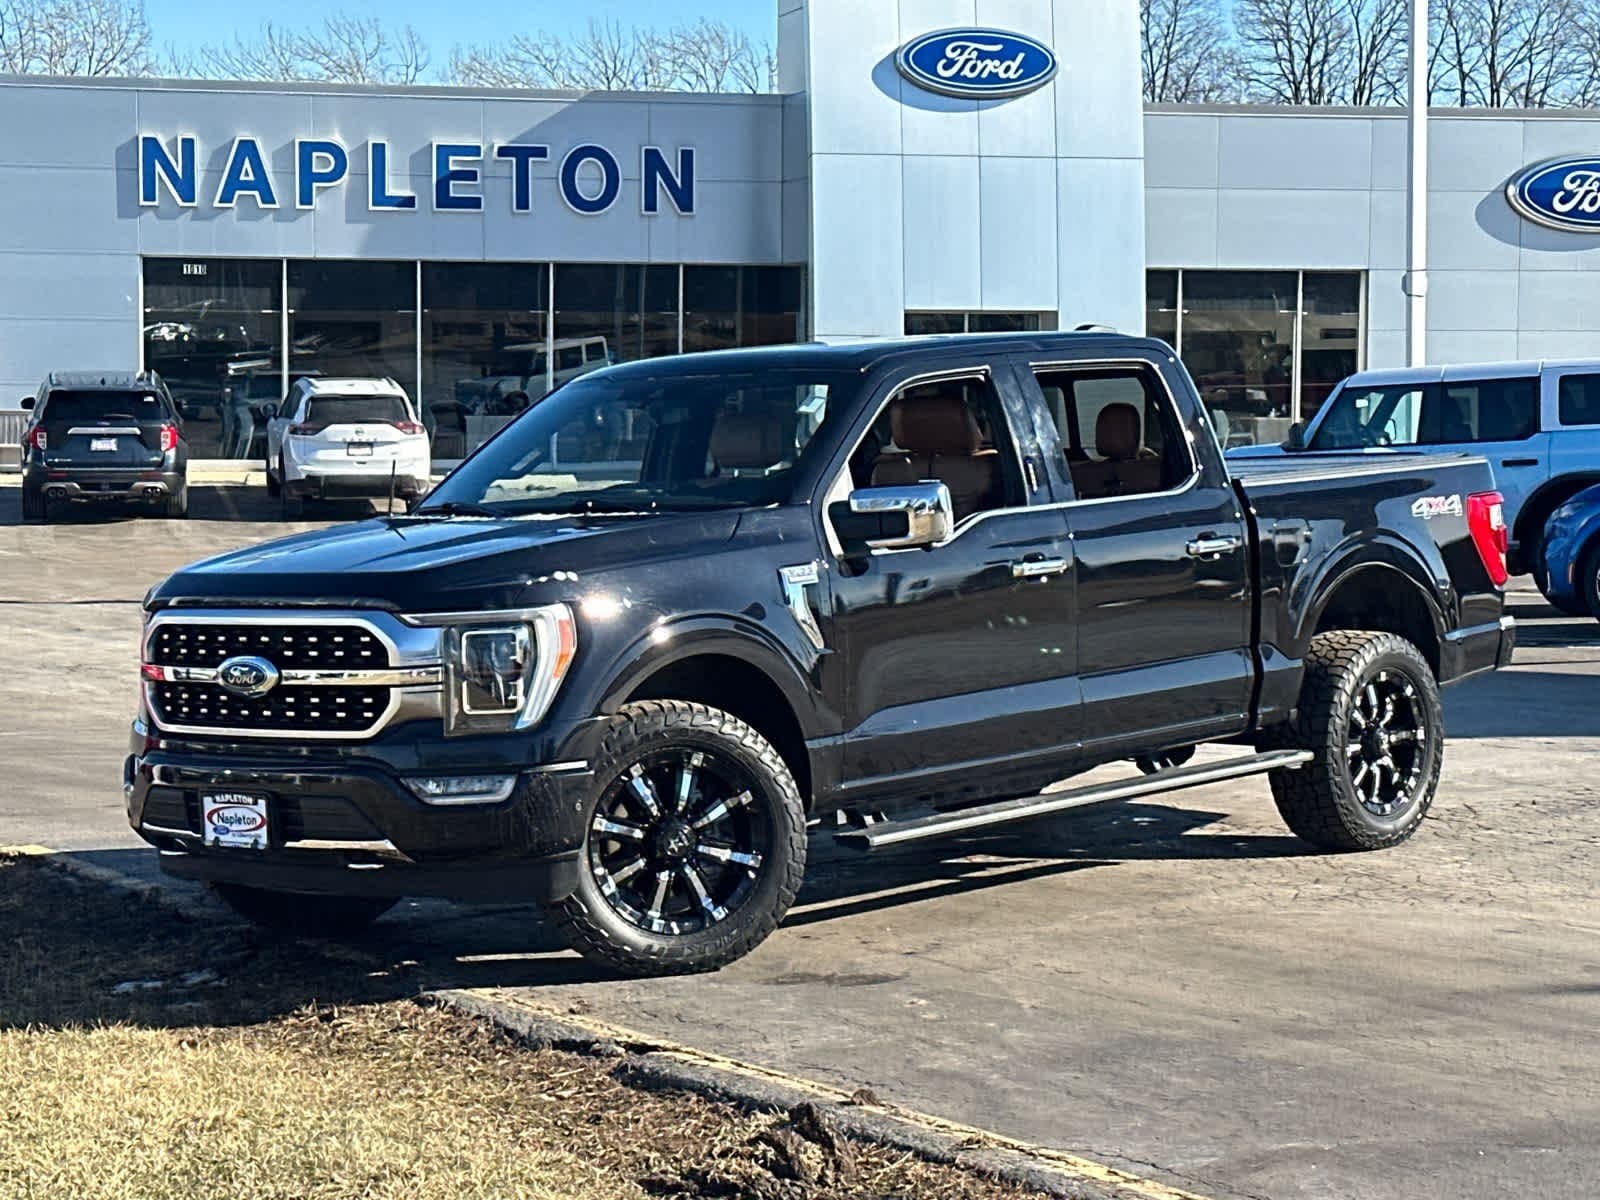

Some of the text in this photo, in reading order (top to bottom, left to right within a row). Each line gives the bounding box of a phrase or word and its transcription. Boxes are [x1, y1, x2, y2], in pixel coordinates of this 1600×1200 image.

[936, 41, 1025, 79] Ford
[138, 133, 696, 215] NAPLETON
[1552, 170, 1600, 213] Fo
[228, 665, 257, 684] Ford
[214, 794, 254, 804] NAPLETON
[217, 812, 257, 827] Napleton
